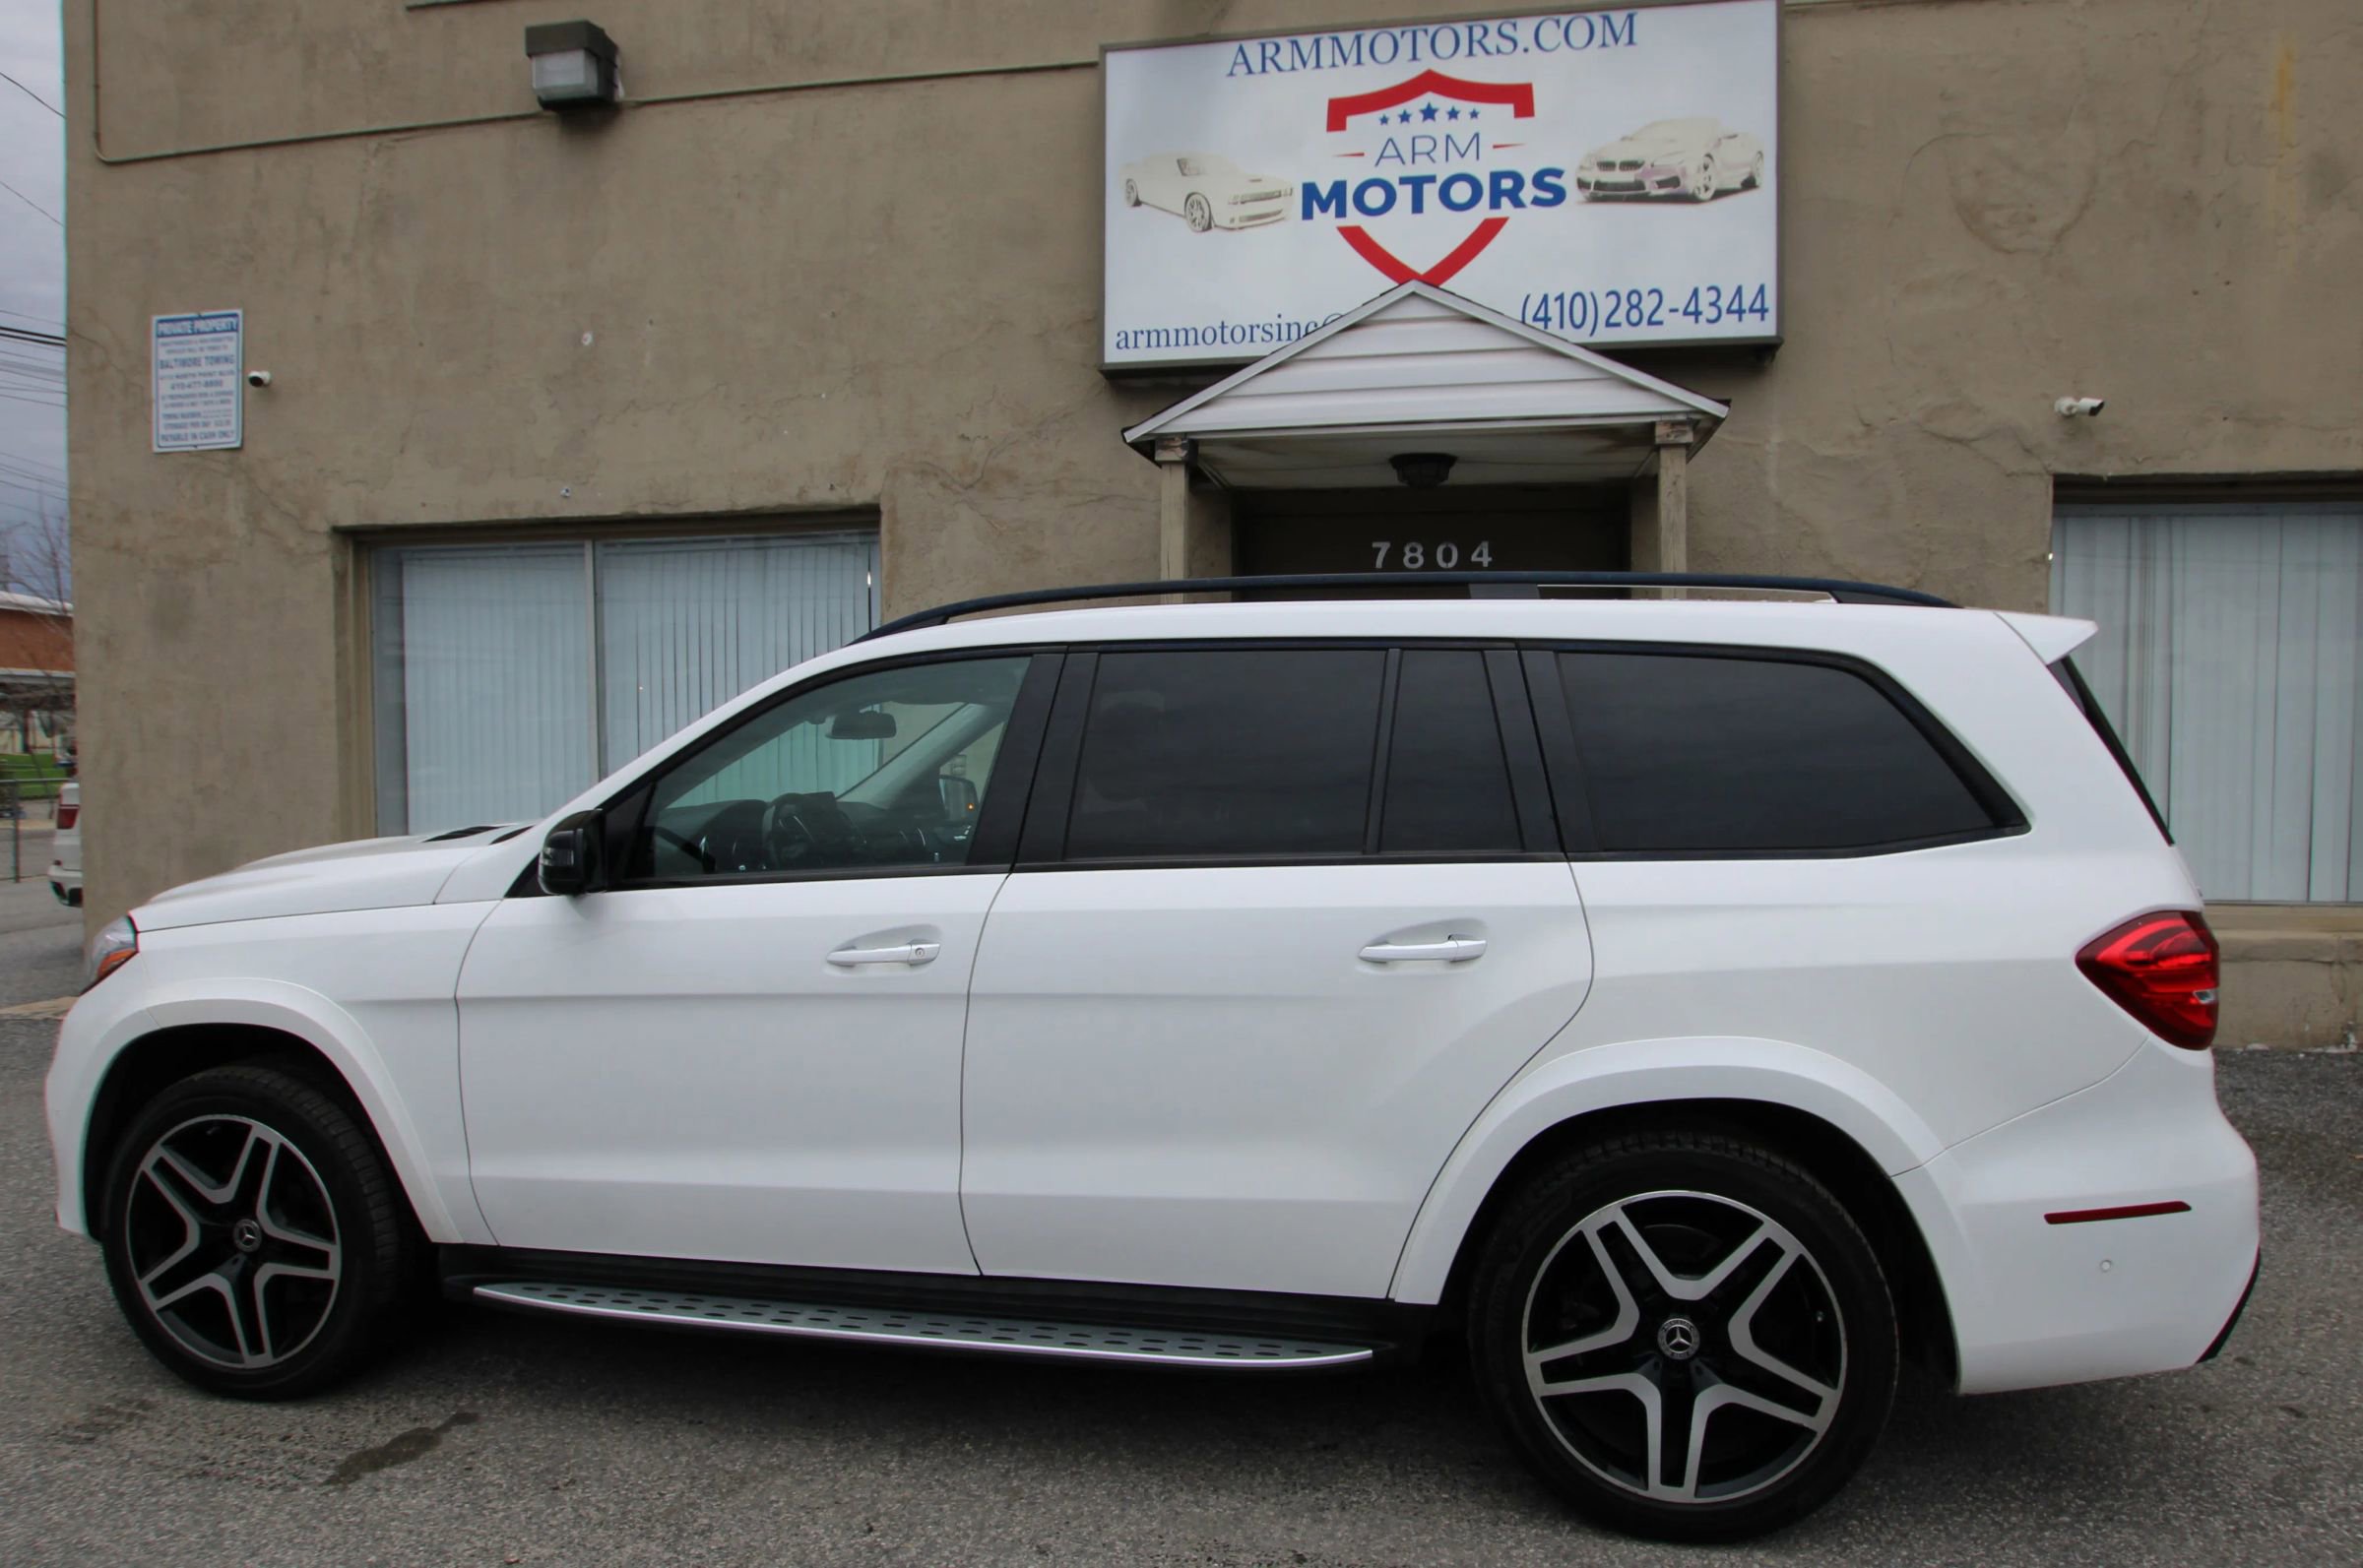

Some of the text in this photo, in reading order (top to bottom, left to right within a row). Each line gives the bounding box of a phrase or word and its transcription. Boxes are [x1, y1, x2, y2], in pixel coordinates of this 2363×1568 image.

[1227, 12, 1638, 77] ARMMOTORS.COM
[1374, 132, 1481, 167] ARM
[1301, 166, 1567, 221] MOTORS
[1520, 282, 1770, 337] (410)282-4344
[1372, 541, 1493, 569] 7804
